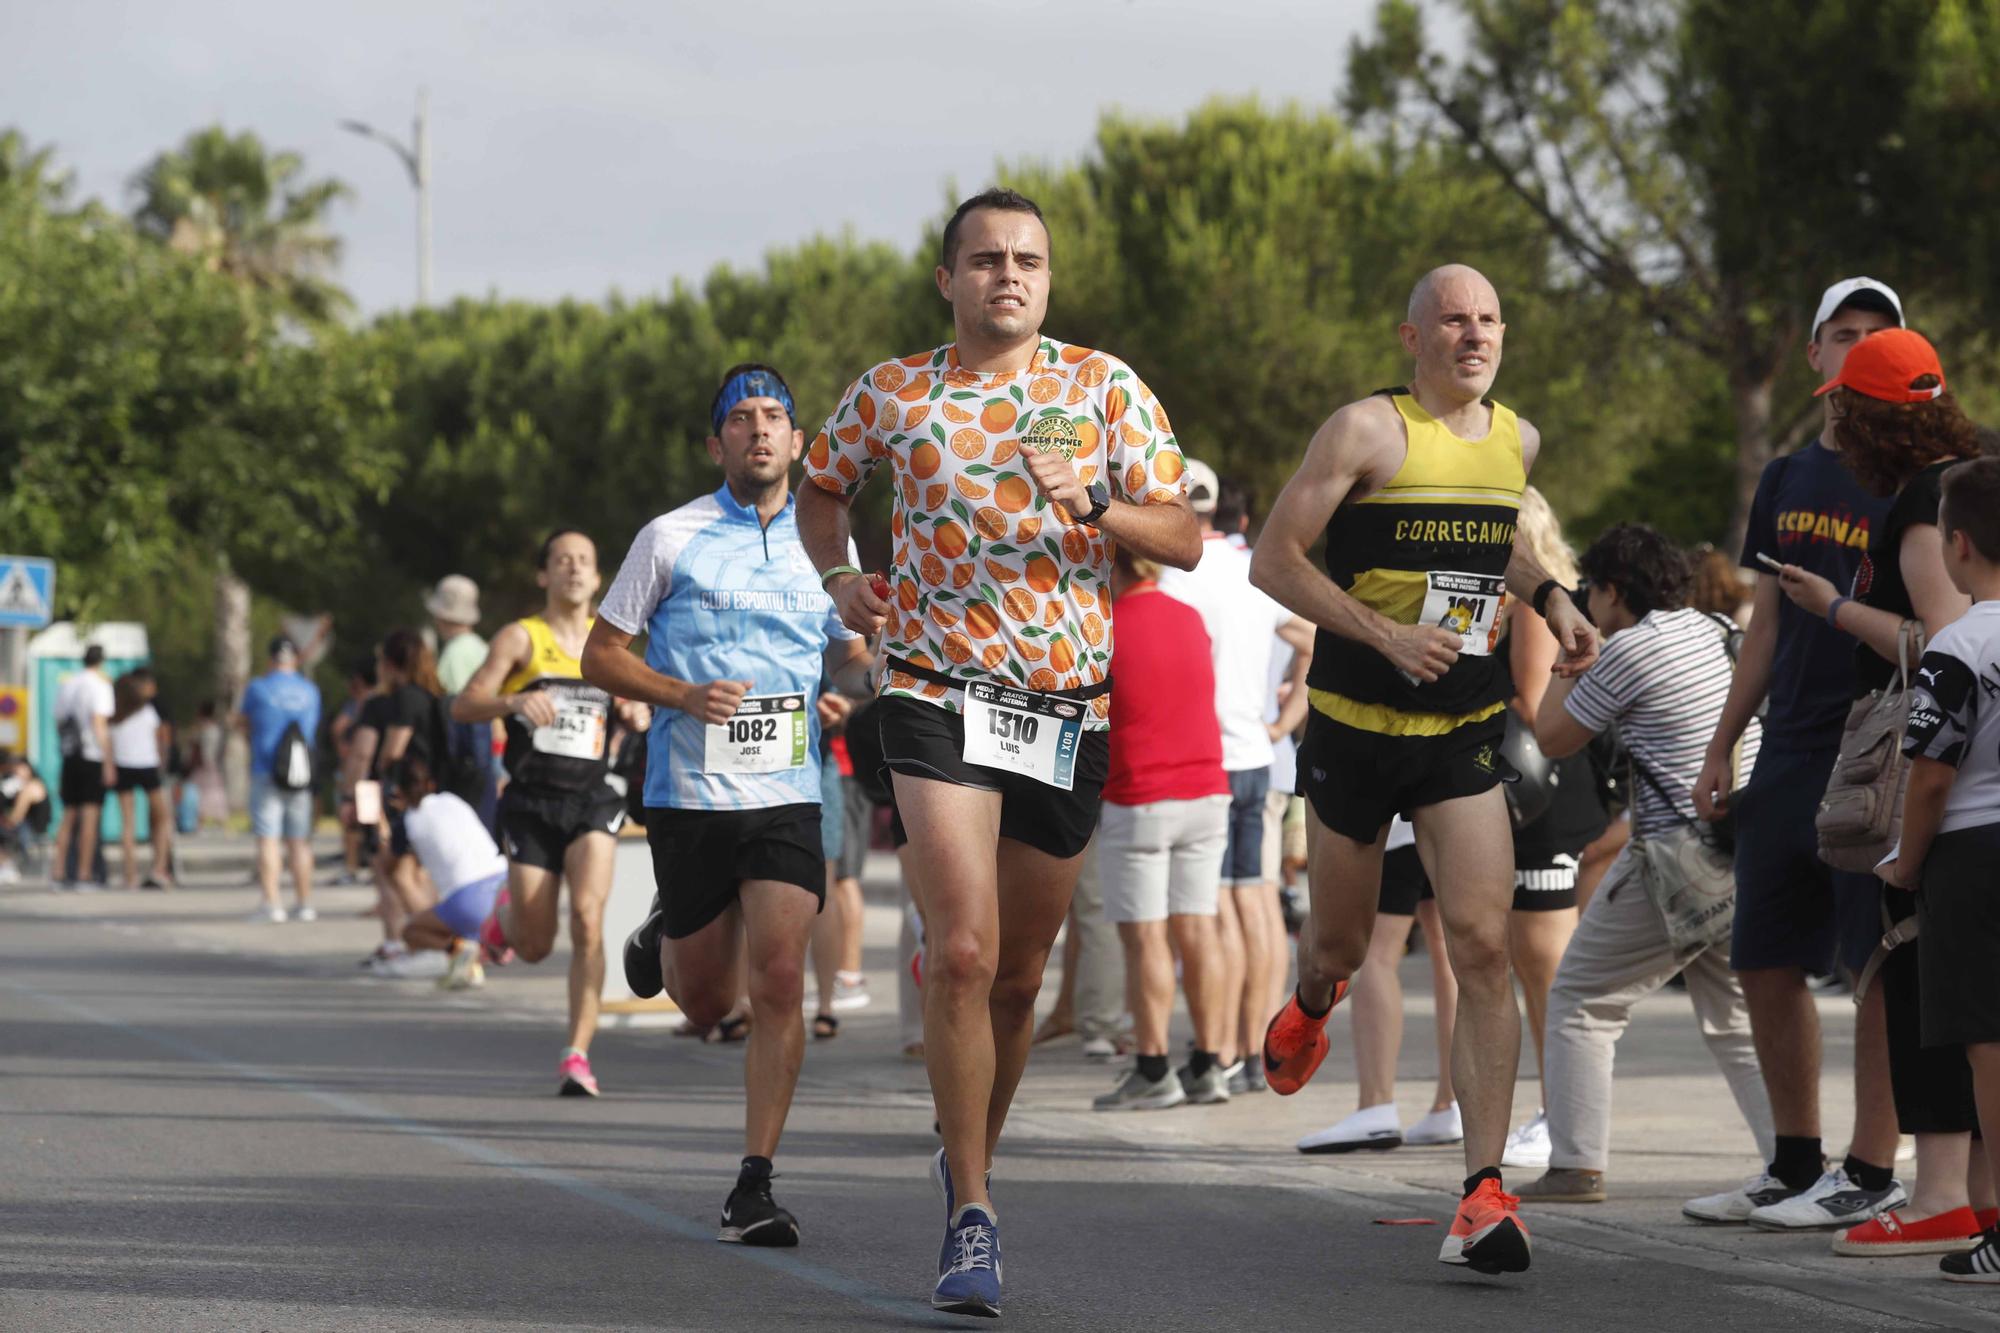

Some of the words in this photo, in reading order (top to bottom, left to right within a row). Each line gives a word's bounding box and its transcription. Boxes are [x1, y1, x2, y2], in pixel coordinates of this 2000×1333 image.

[1033, 419, 1058, 434] SPORTS
[1060, 419, 1074, 436] TEAM
[1021, 436, 1051, 444] GREEN
[1054, 437, 1082, 447] POWER
[701, 591, 730, 610] CLUB
[733, 590, 784, 611] ESPORTIU
[975, 690, 989, 700] VILA
[1000, 697, 1028, 708] PATERNA
[1001, 691, 1029, 701] ARATÓN
[727, 718, 777, 743] 1082
[987, 708, 1038, 744] 1310
[739, 746, 762, 755] JOSE
[1000, 741, 1020, 754] LUIS
[1062, 732, 1074, 751] BOX
[1516, 868, 1574, 891] PUMA
